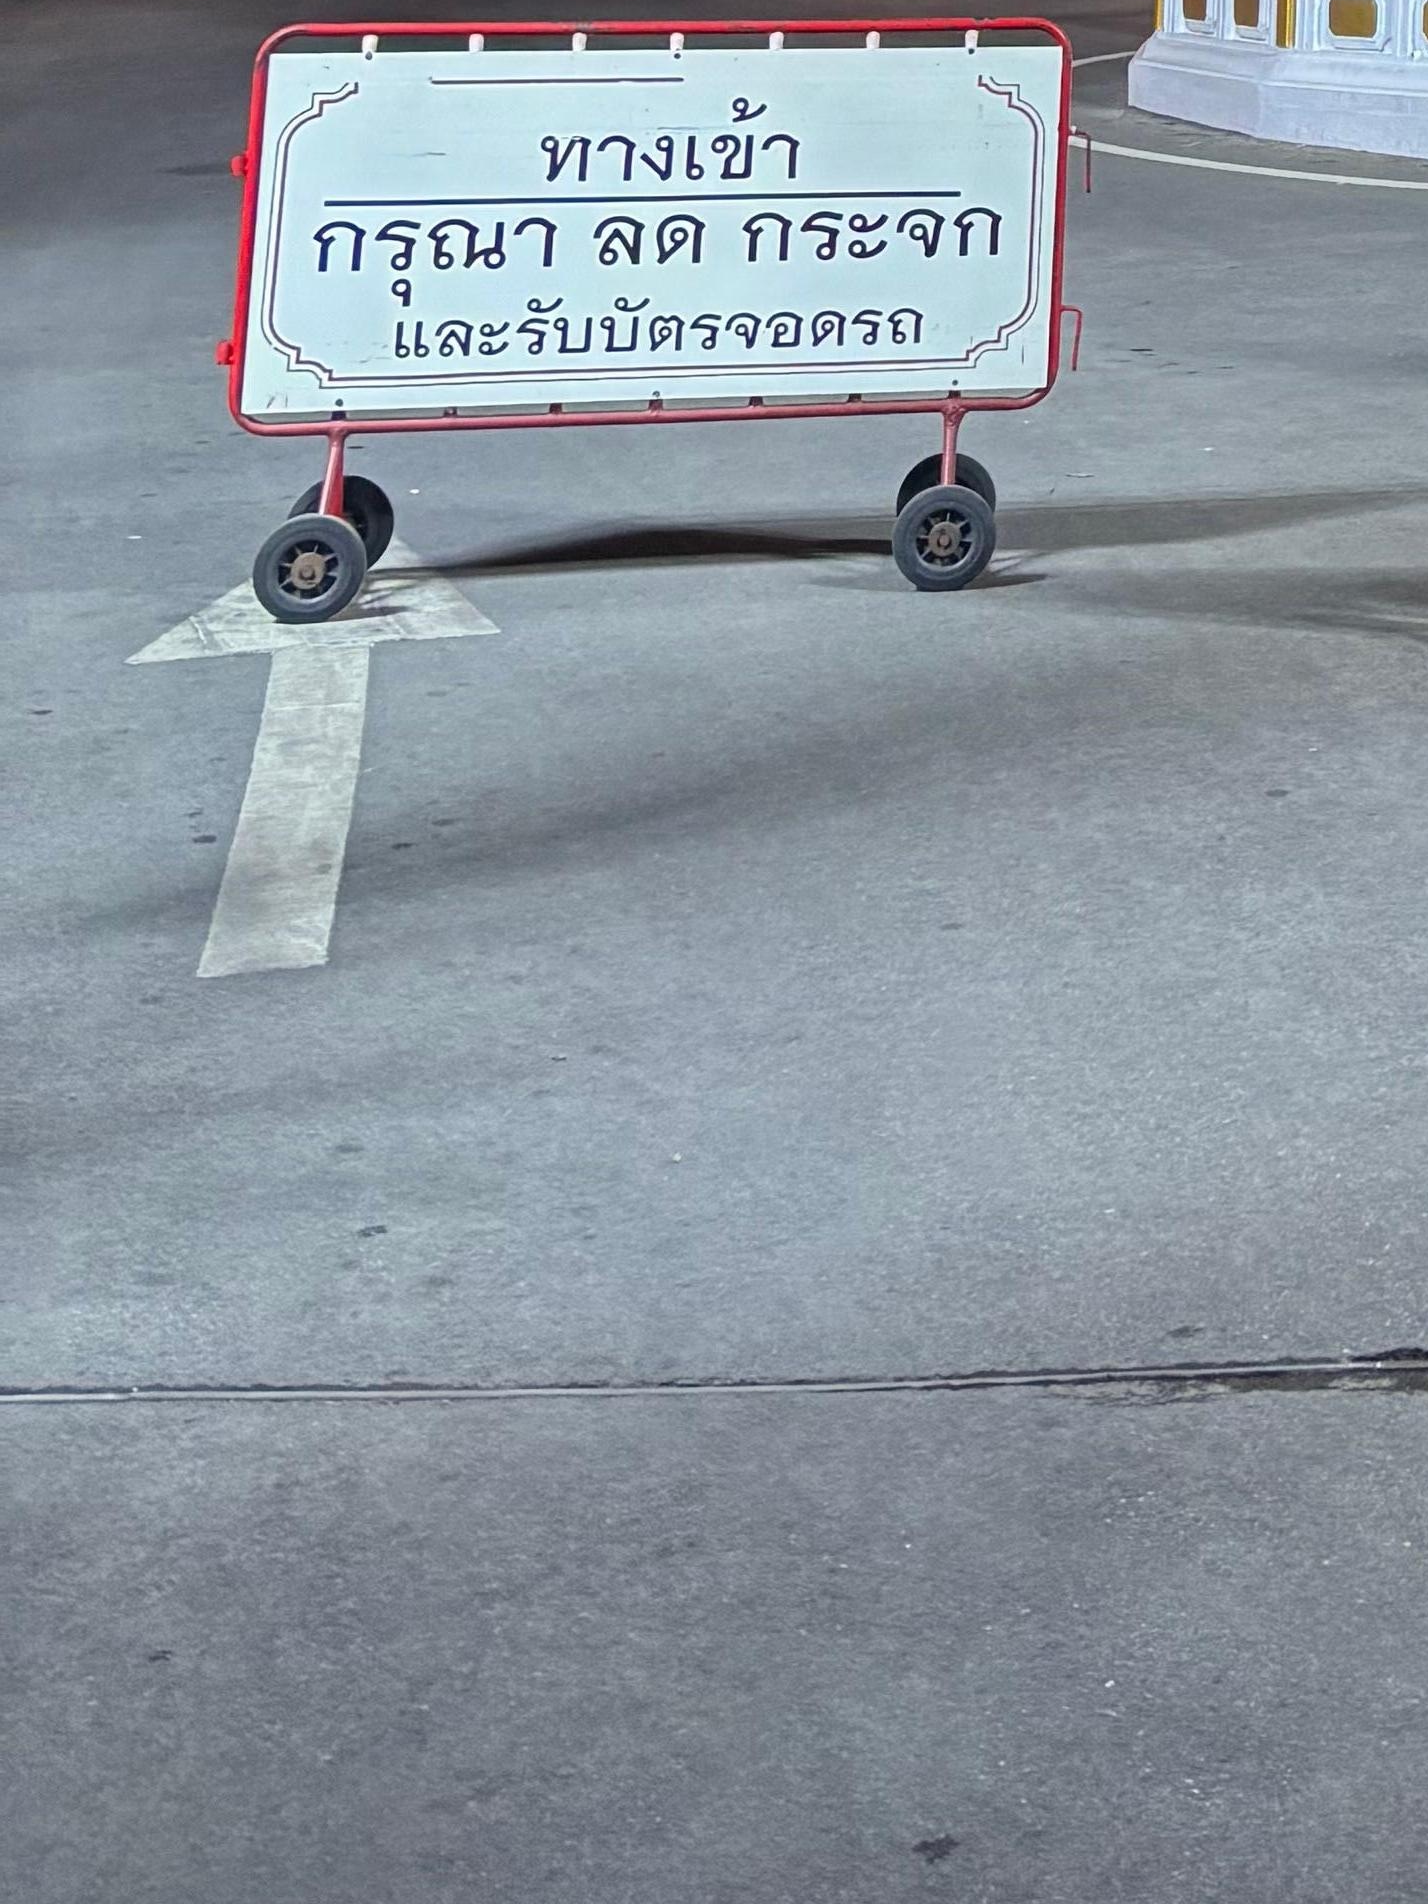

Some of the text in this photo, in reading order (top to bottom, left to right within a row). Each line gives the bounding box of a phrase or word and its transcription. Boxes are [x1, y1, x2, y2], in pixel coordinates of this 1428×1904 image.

[541, 97, 799, 182] ทางเข้า
[314, 204, 1002, 307] กรุณา ลด กระจก
[392, 296, 924, 359] และรับบัตรจอดรถ
